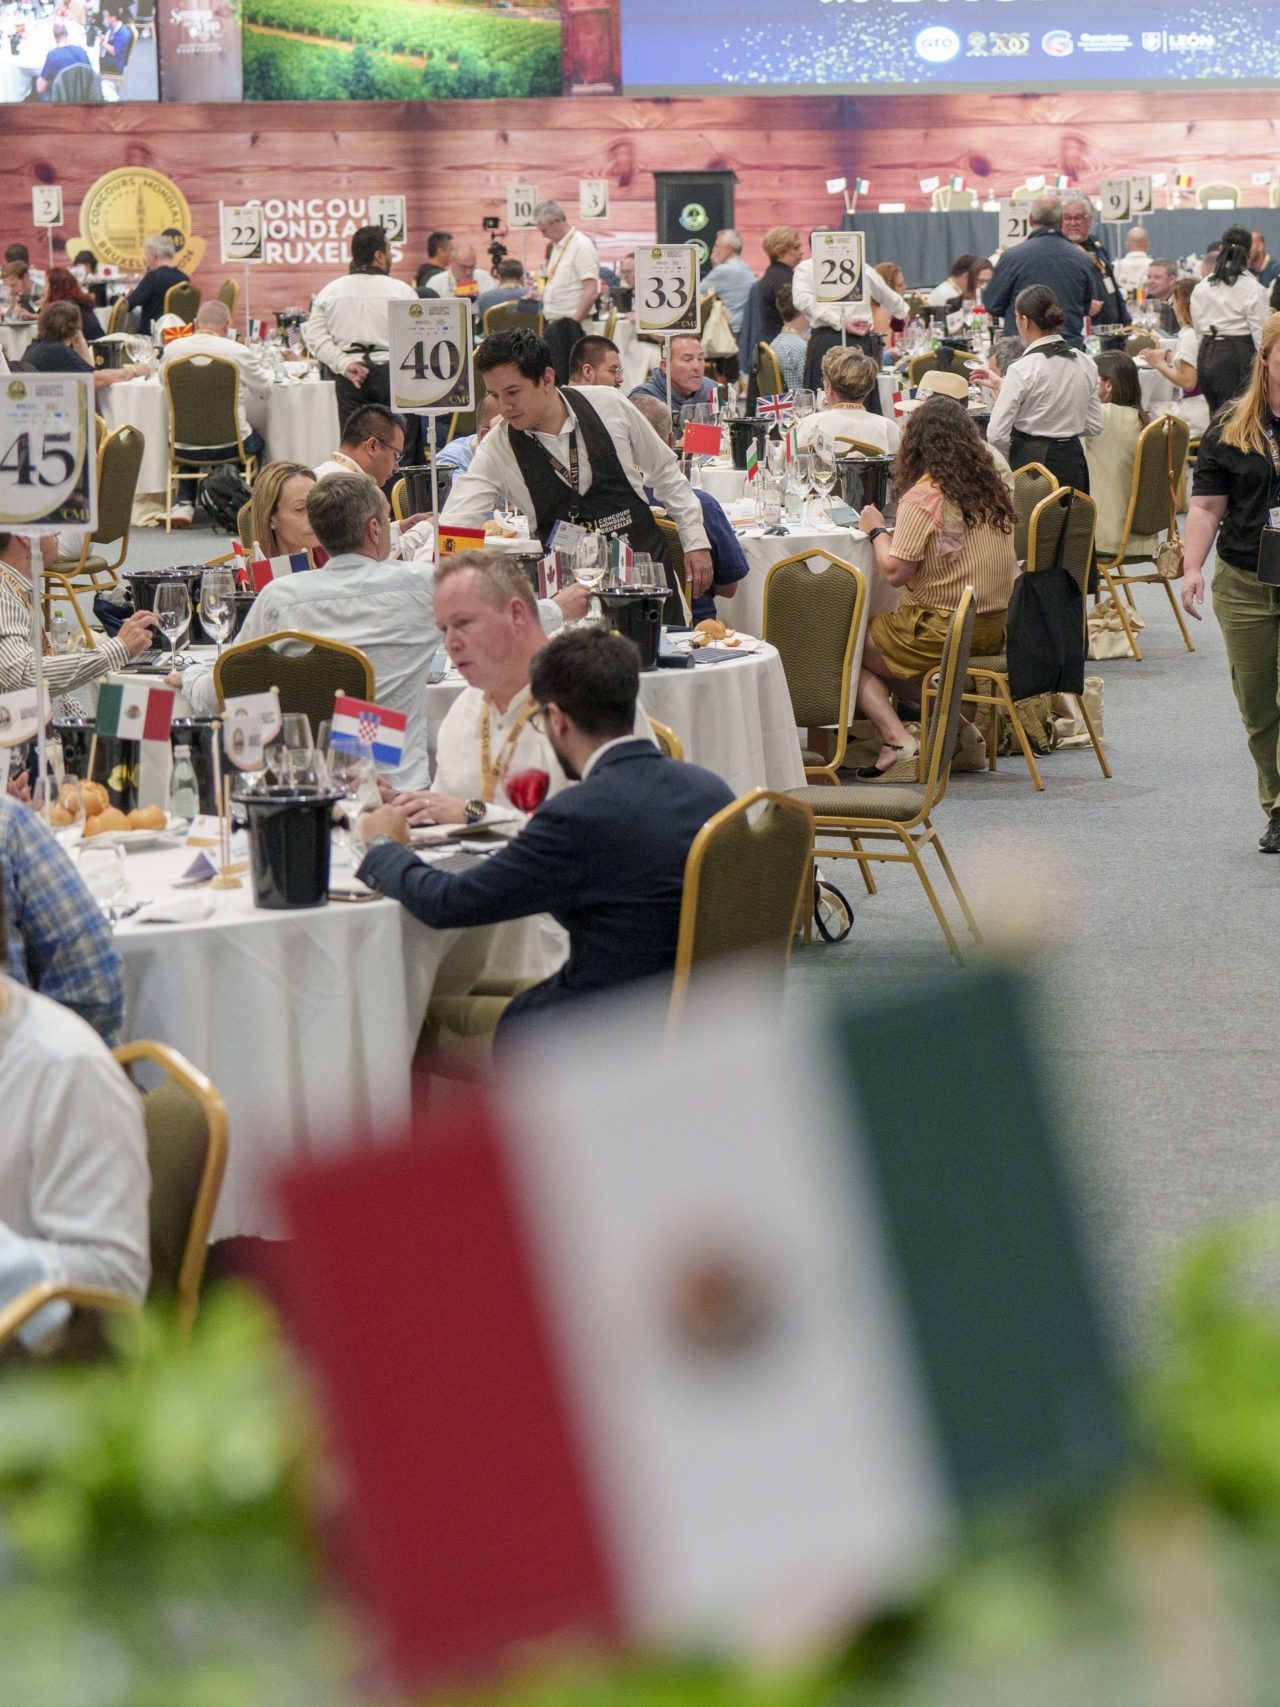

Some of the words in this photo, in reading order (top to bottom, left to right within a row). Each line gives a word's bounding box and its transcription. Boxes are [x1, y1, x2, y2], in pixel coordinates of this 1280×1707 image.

[91, 177, 136, 226] CONCOURS
[144, 180, 180, 224] MONDIAL
[588, 195, 599, 208] 3
[1110, 195, 1121, 210] 9
[1133, 190, 1143, 203] 4
[42, 202, 53, 215] 2
[514, 202, 532, 217] 10
[262, 219, 368, 240] ONDIA
[378, 214, 398, 231] 15
[1007, 218, 1028, 237] 21
[231, 226, 257, 246] 22
[265, 242, 404, 264] RUXELS
[820, 259, 856, 285] 28
[645, 277, 688, 309] 33
[400, 340, 460, 380] 40
[0, 432, 75, 487] 45
[598, 509, 631, 524] CONCOURS
[603, 518, 633, 533] RUXELLES
